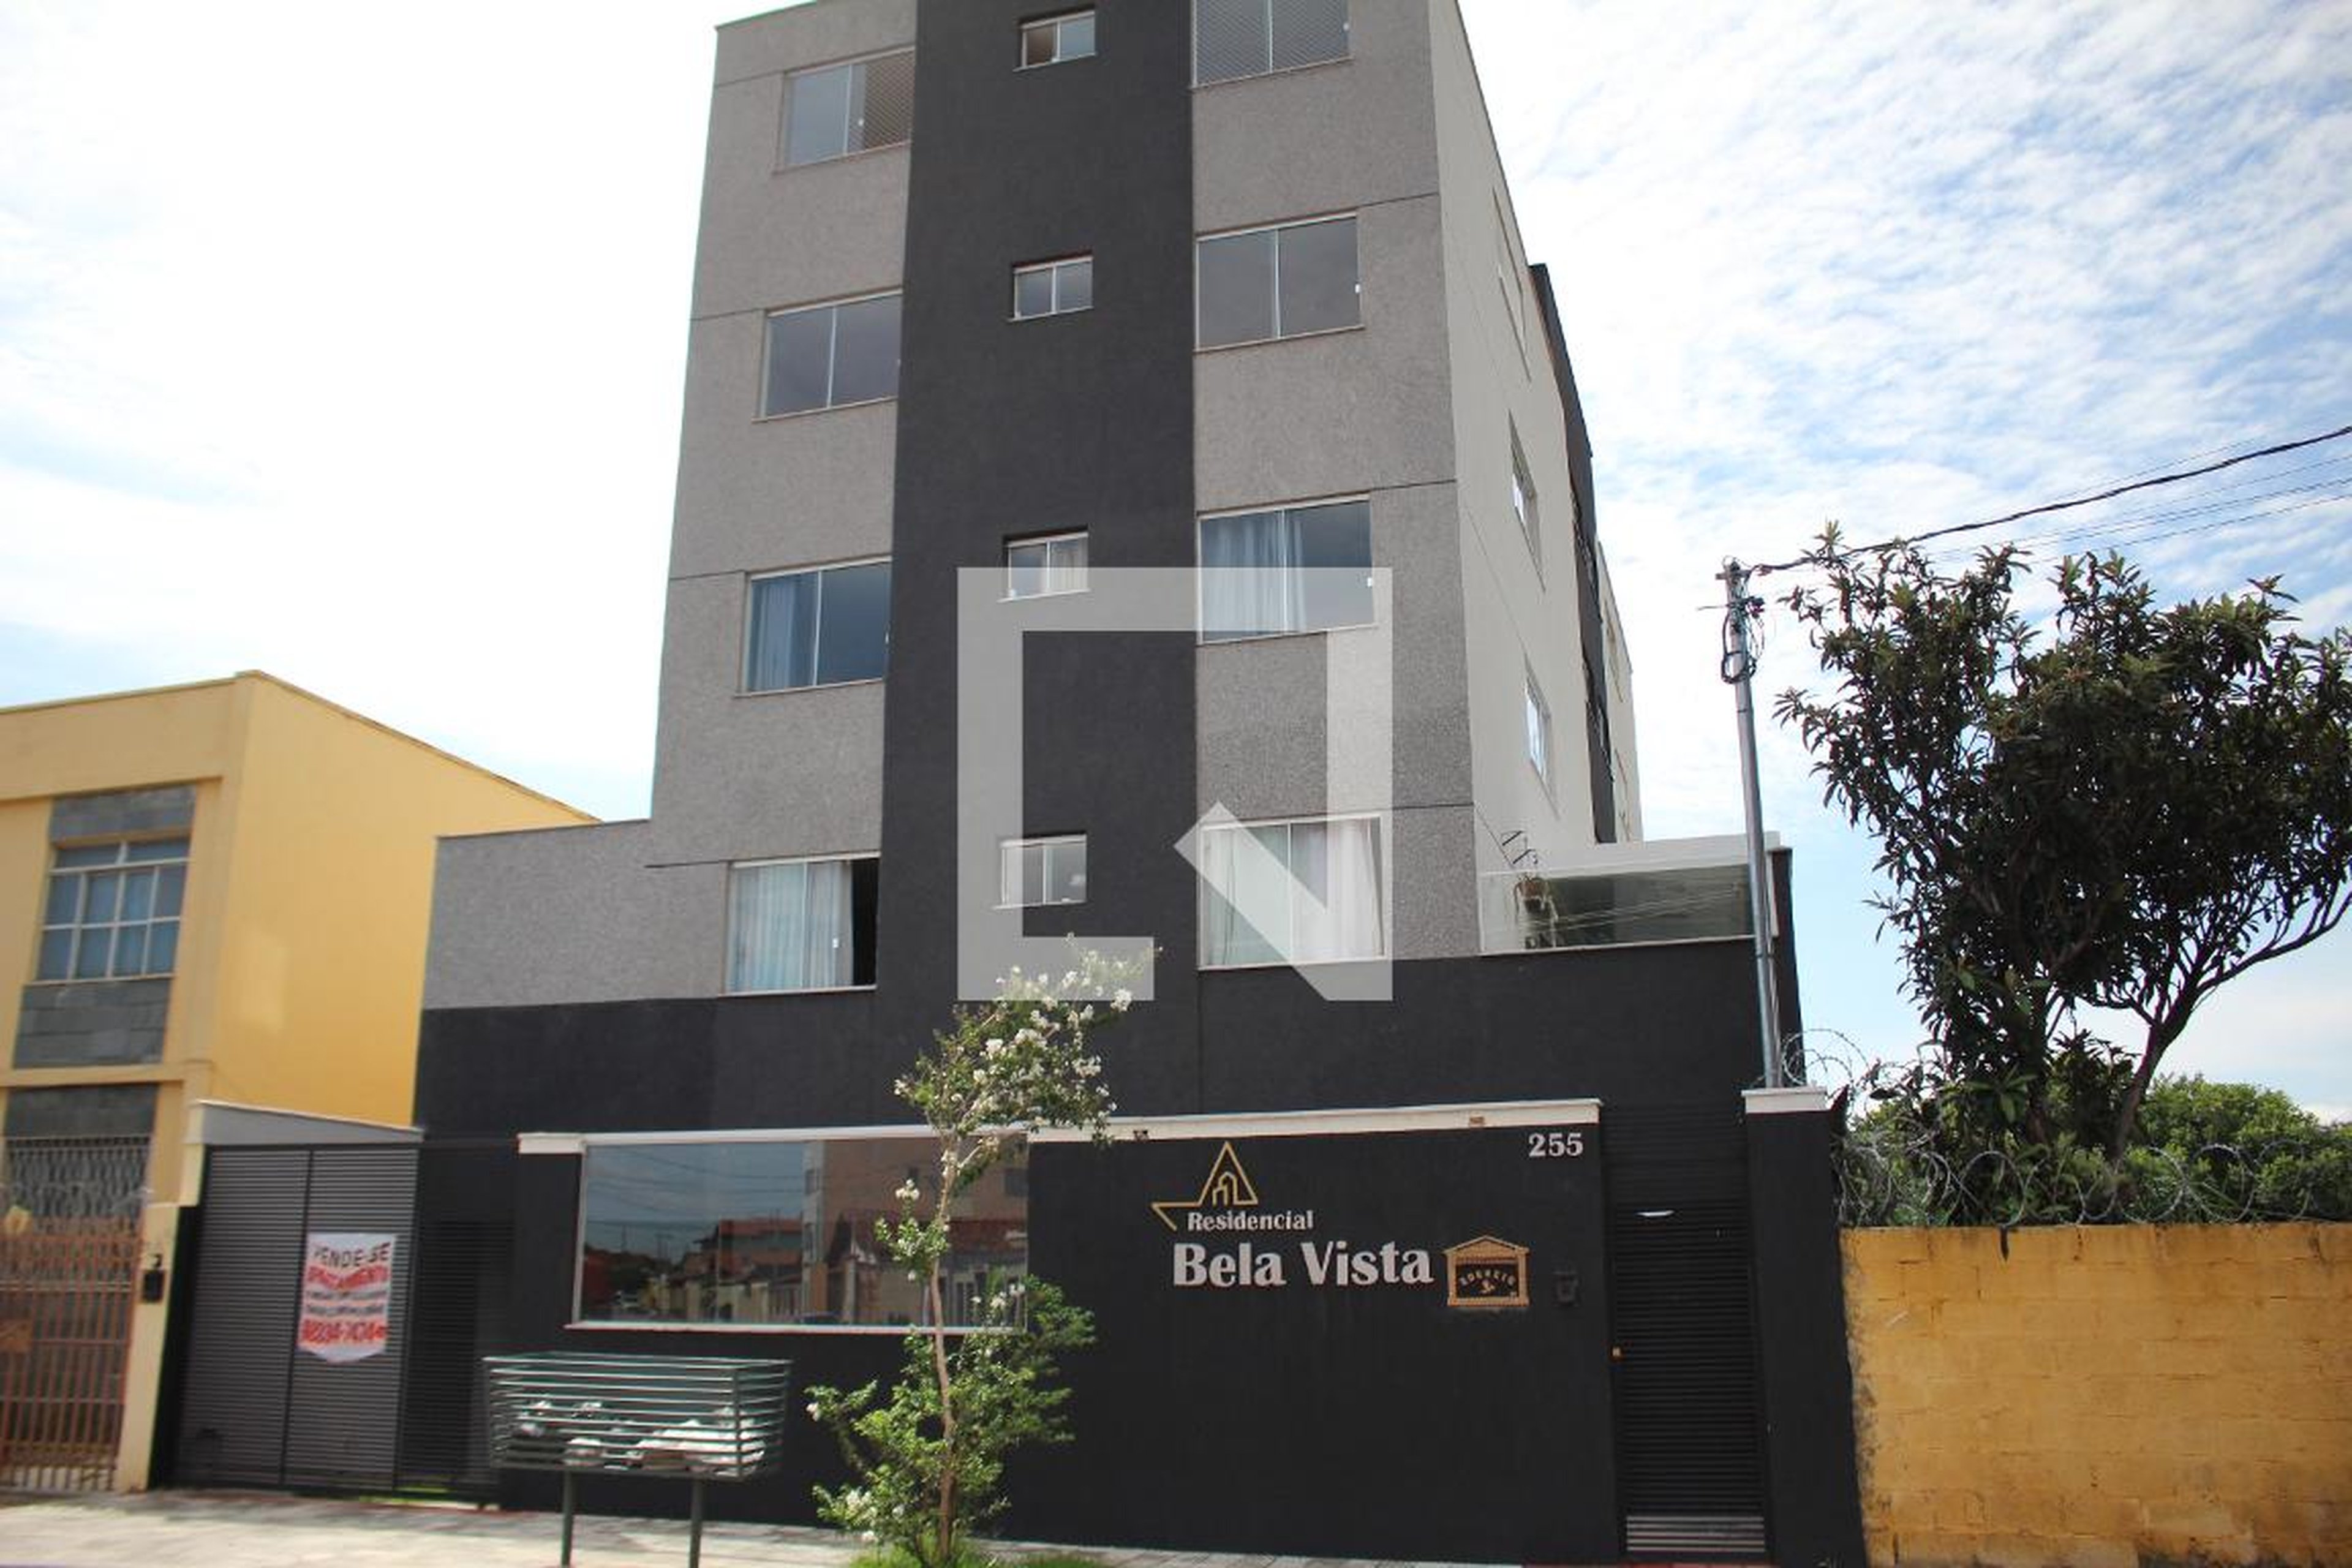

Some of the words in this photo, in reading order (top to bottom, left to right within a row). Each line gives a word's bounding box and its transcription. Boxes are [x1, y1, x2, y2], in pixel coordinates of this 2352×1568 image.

[1529, 1133, 1583, 1157] 255
[1188, 1210, 1314, 1231] Residencial
[1174, 1242, 1287, 1287] Bela
[1301, 1240, 1434, 1286] Vista
